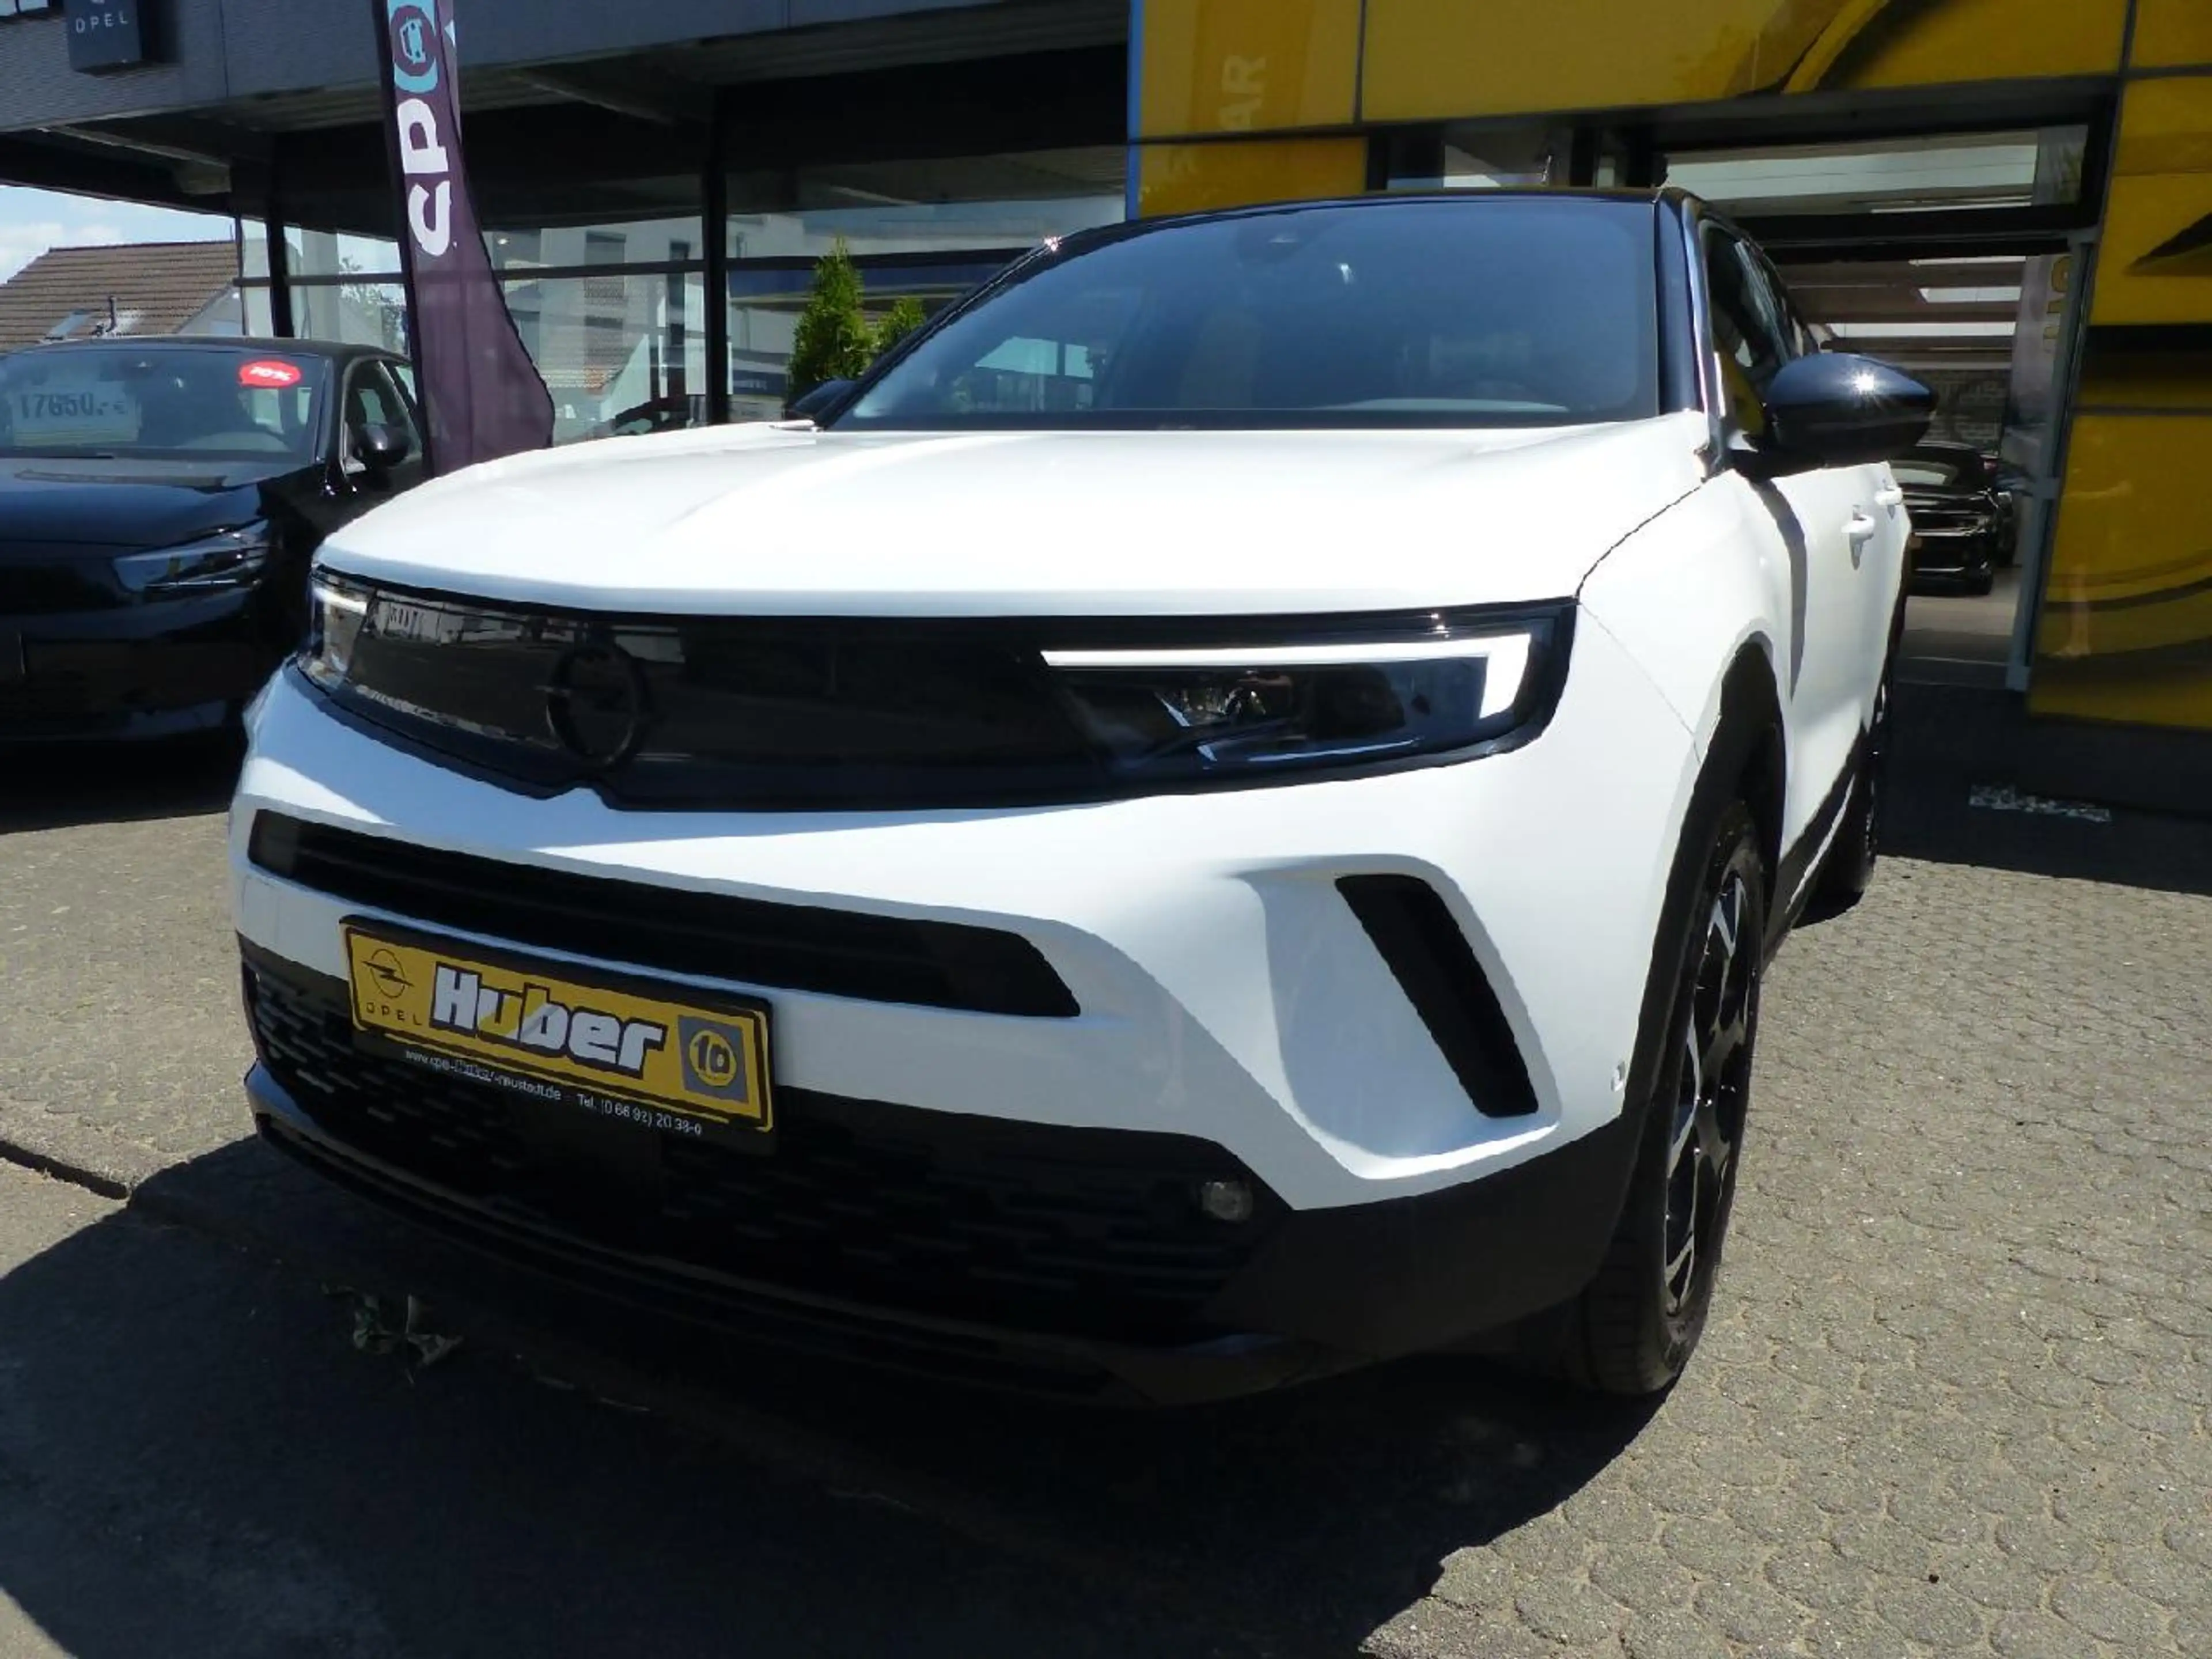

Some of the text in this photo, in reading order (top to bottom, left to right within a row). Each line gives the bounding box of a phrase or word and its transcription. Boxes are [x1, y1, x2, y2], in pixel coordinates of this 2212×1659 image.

[75, 10, 128, 33] OPEL
[365, 1002, 423, 1026] OPEL
[429, 961, 668, 1079] Huber
[577, 1093, 597, 1109] Tel.
[656, 1112, 672, 1129] 20
